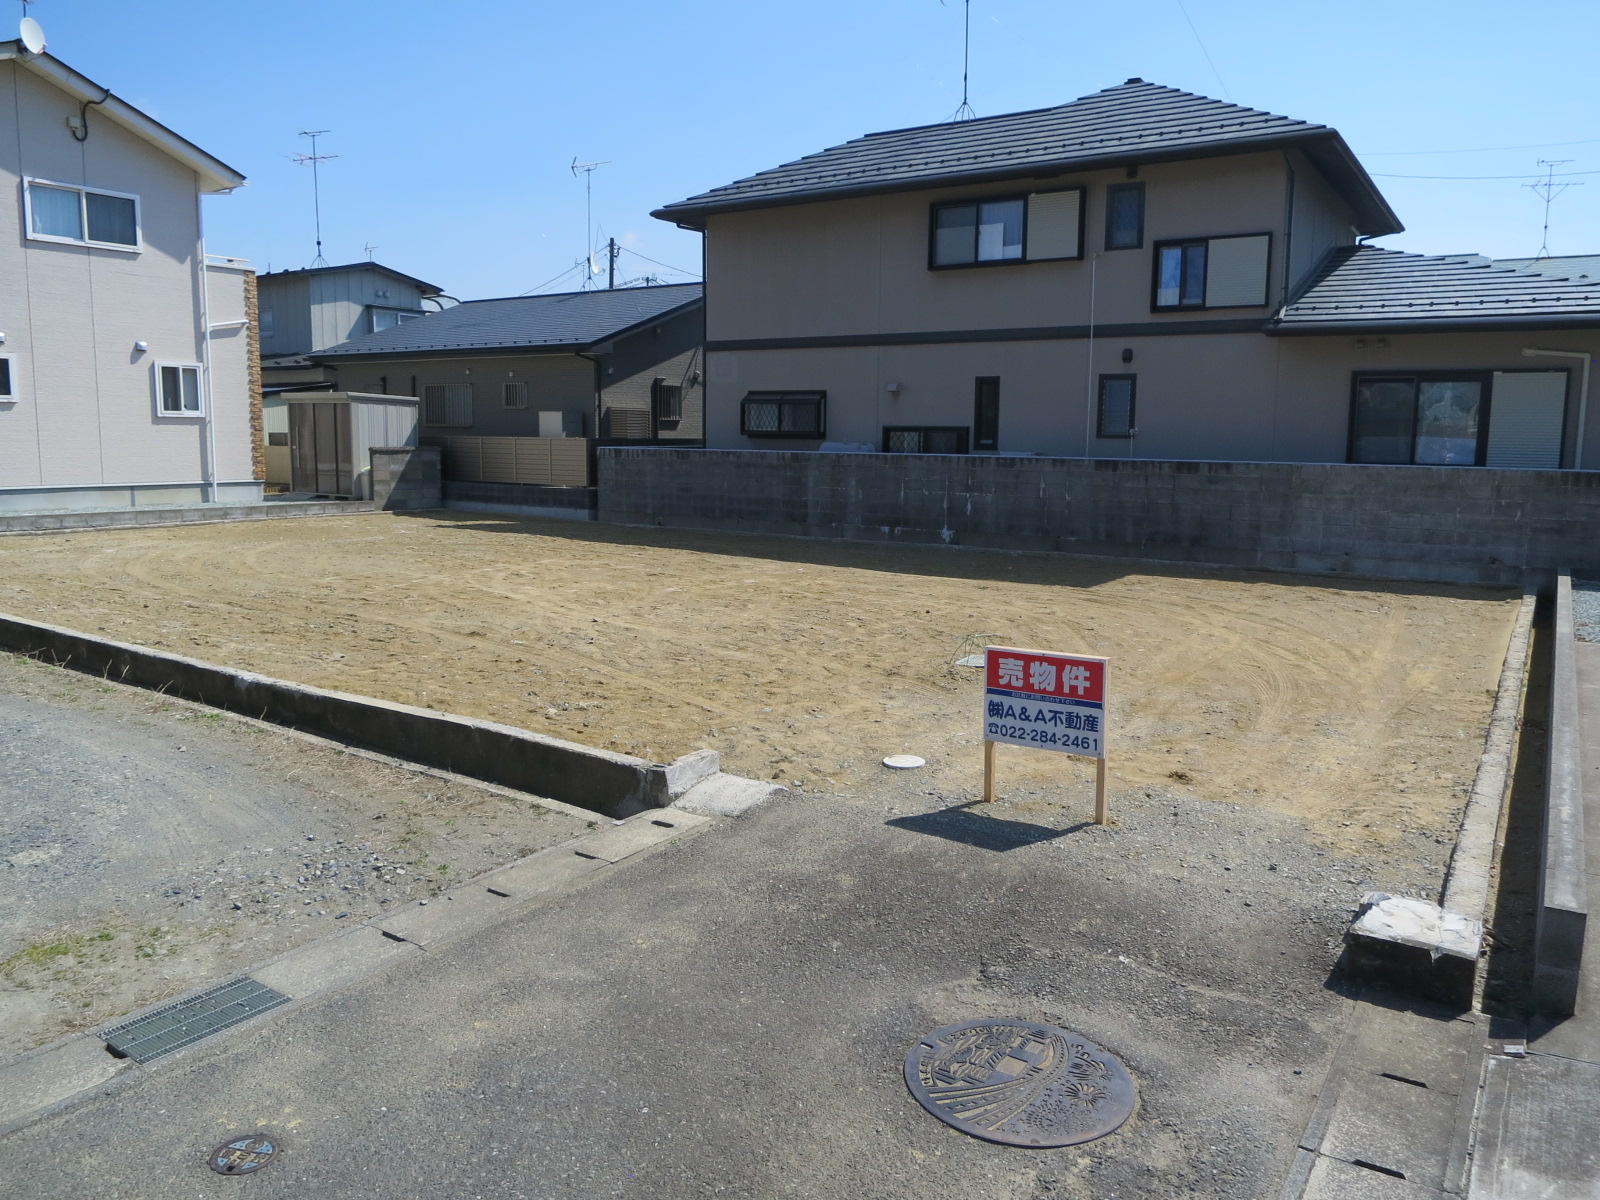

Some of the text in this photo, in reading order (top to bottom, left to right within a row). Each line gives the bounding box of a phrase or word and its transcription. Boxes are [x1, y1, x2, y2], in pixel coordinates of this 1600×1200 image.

[998, 658, 1091, 695] 売物件
[1000, 724, 1098, 751] 022-284-2461
